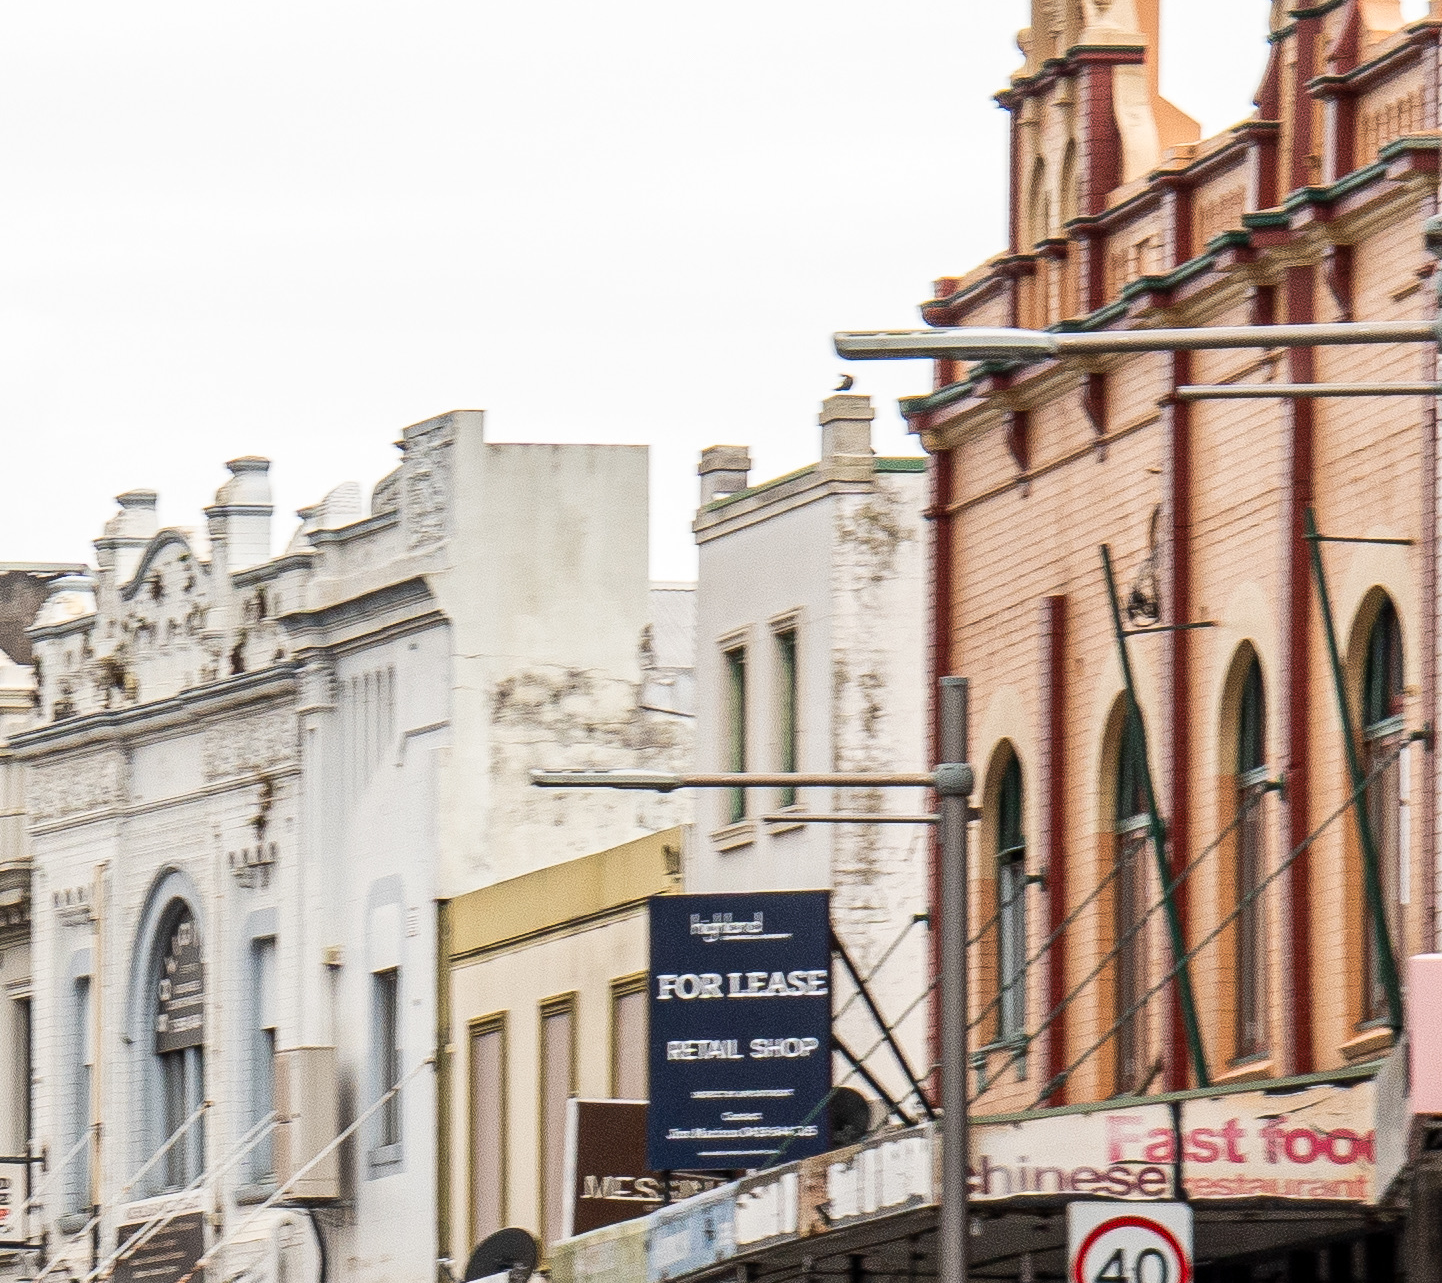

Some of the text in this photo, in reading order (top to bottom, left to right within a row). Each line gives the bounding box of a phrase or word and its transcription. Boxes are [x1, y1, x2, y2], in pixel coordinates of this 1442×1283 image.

[656, 970, 829, 1001] FOR LEASE
[666, 1037, 819, 1061] RETAIL SHOP
[1105, 1115, 1248, 1165] Fast
[967, 1155, 1167, 1196] hinese
